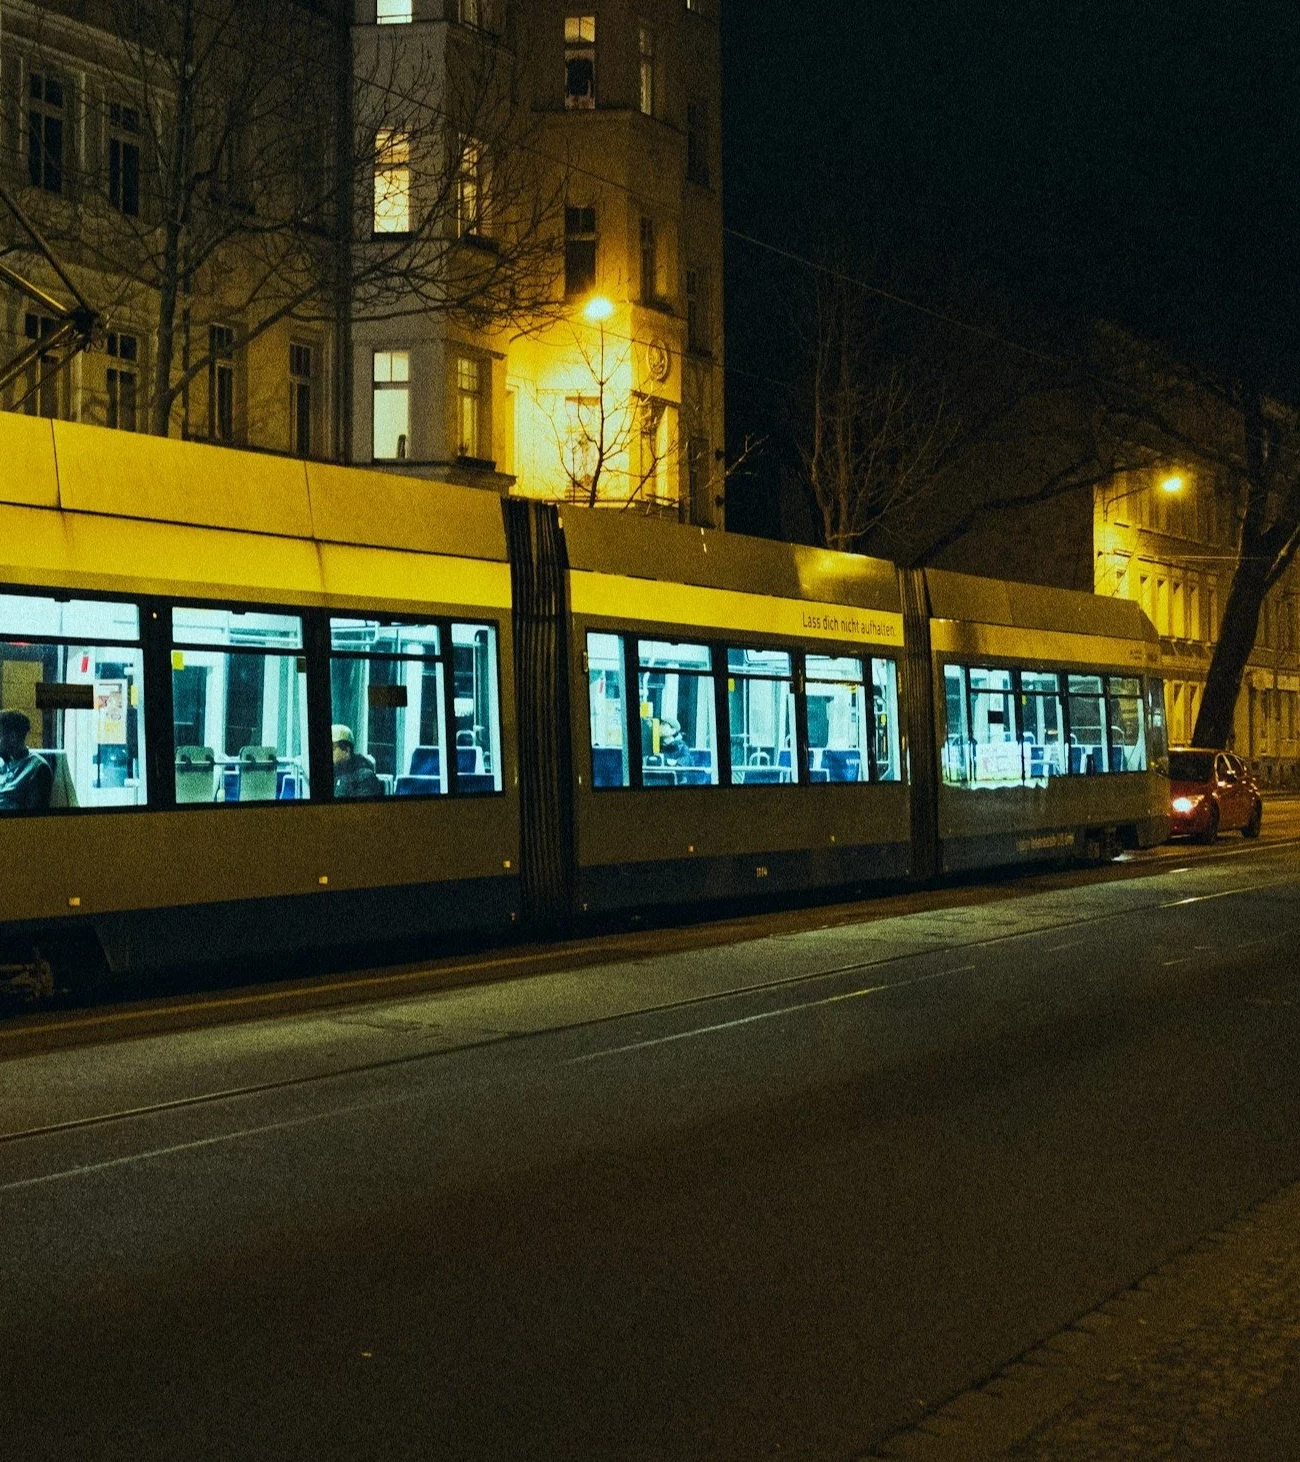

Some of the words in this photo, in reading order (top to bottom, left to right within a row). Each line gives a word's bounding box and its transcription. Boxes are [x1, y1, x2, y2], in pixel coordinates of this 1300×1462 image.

[802, 611, 821, 629] Lass
[823, 614, 839, 631] dich
[840, 616, 860, 633] nicht
